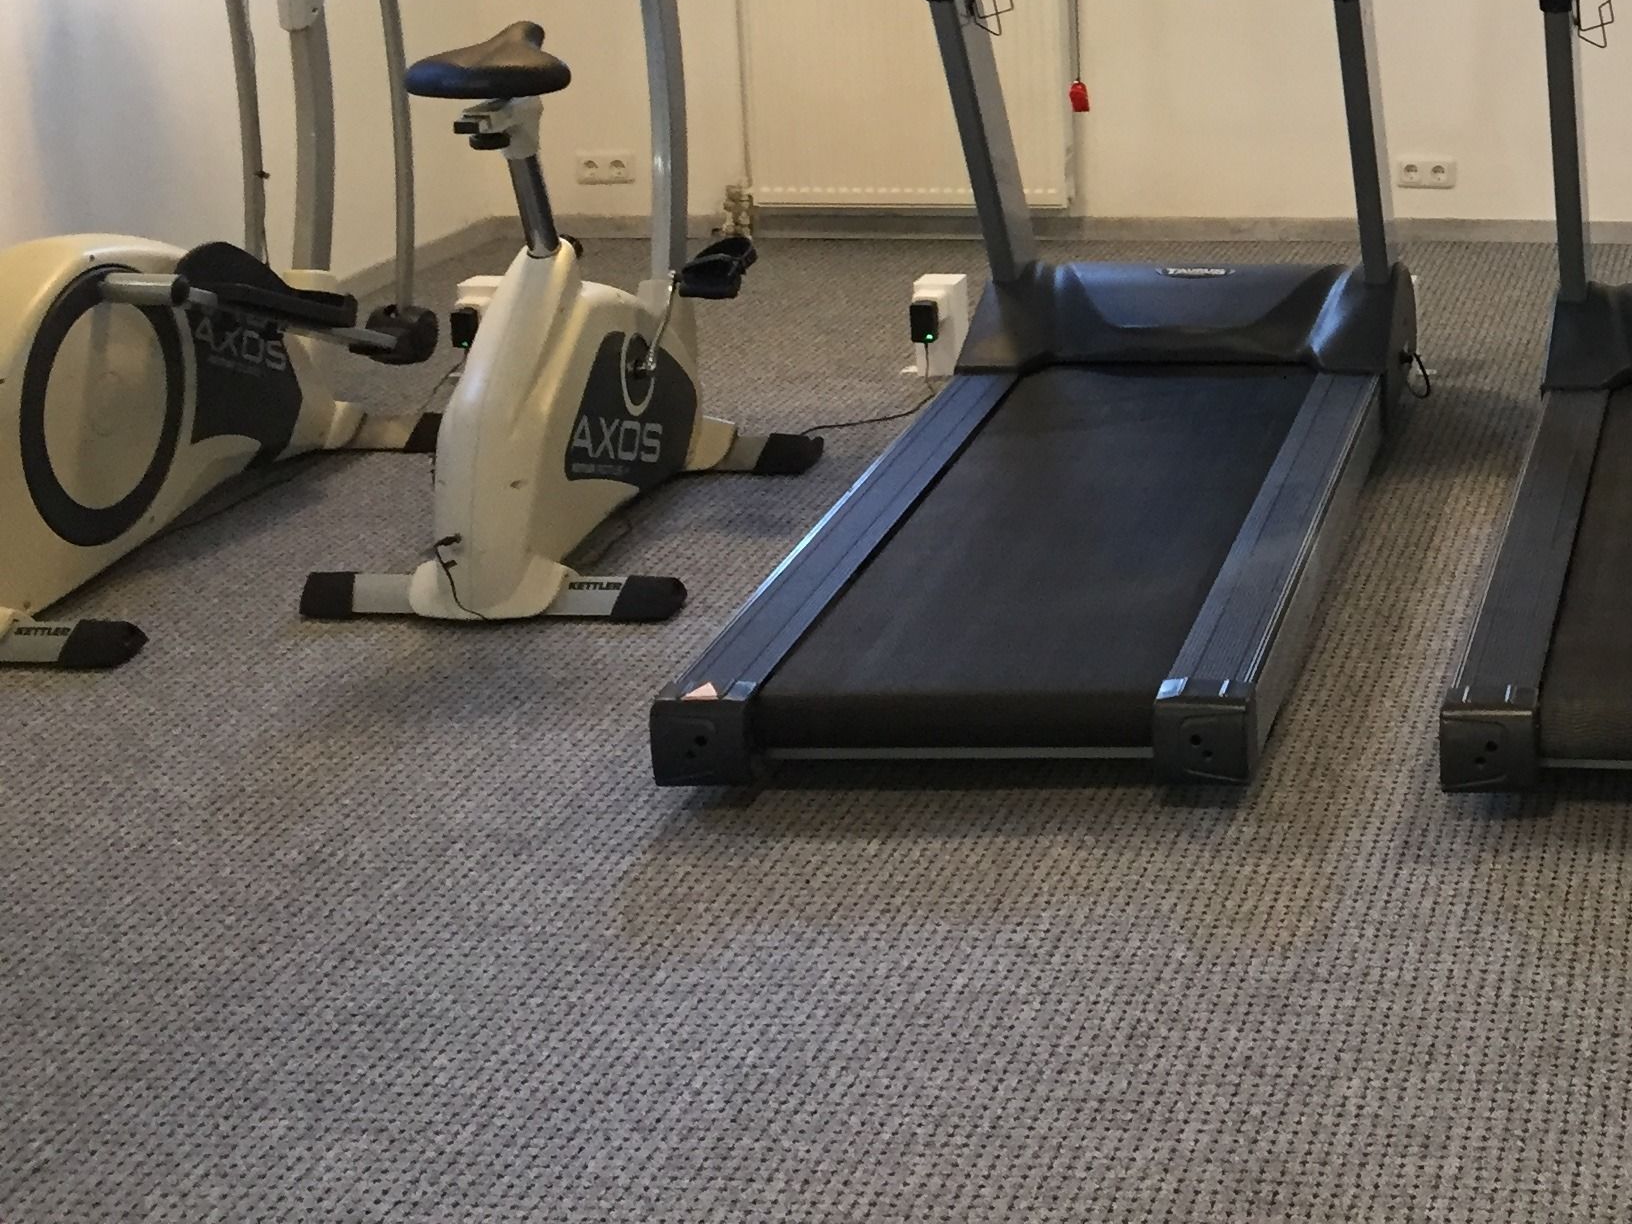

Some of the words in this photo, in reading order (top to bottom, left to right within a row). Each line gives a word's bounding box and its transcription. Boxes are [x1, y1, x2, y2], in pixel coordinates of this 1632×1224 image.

[195, 316, 287, 371] AXOS
[572, 415, 663, 462] AXOS
[568, 582, 622, 590] KETTLER
[14, 627, 71, 636] KETTLER
